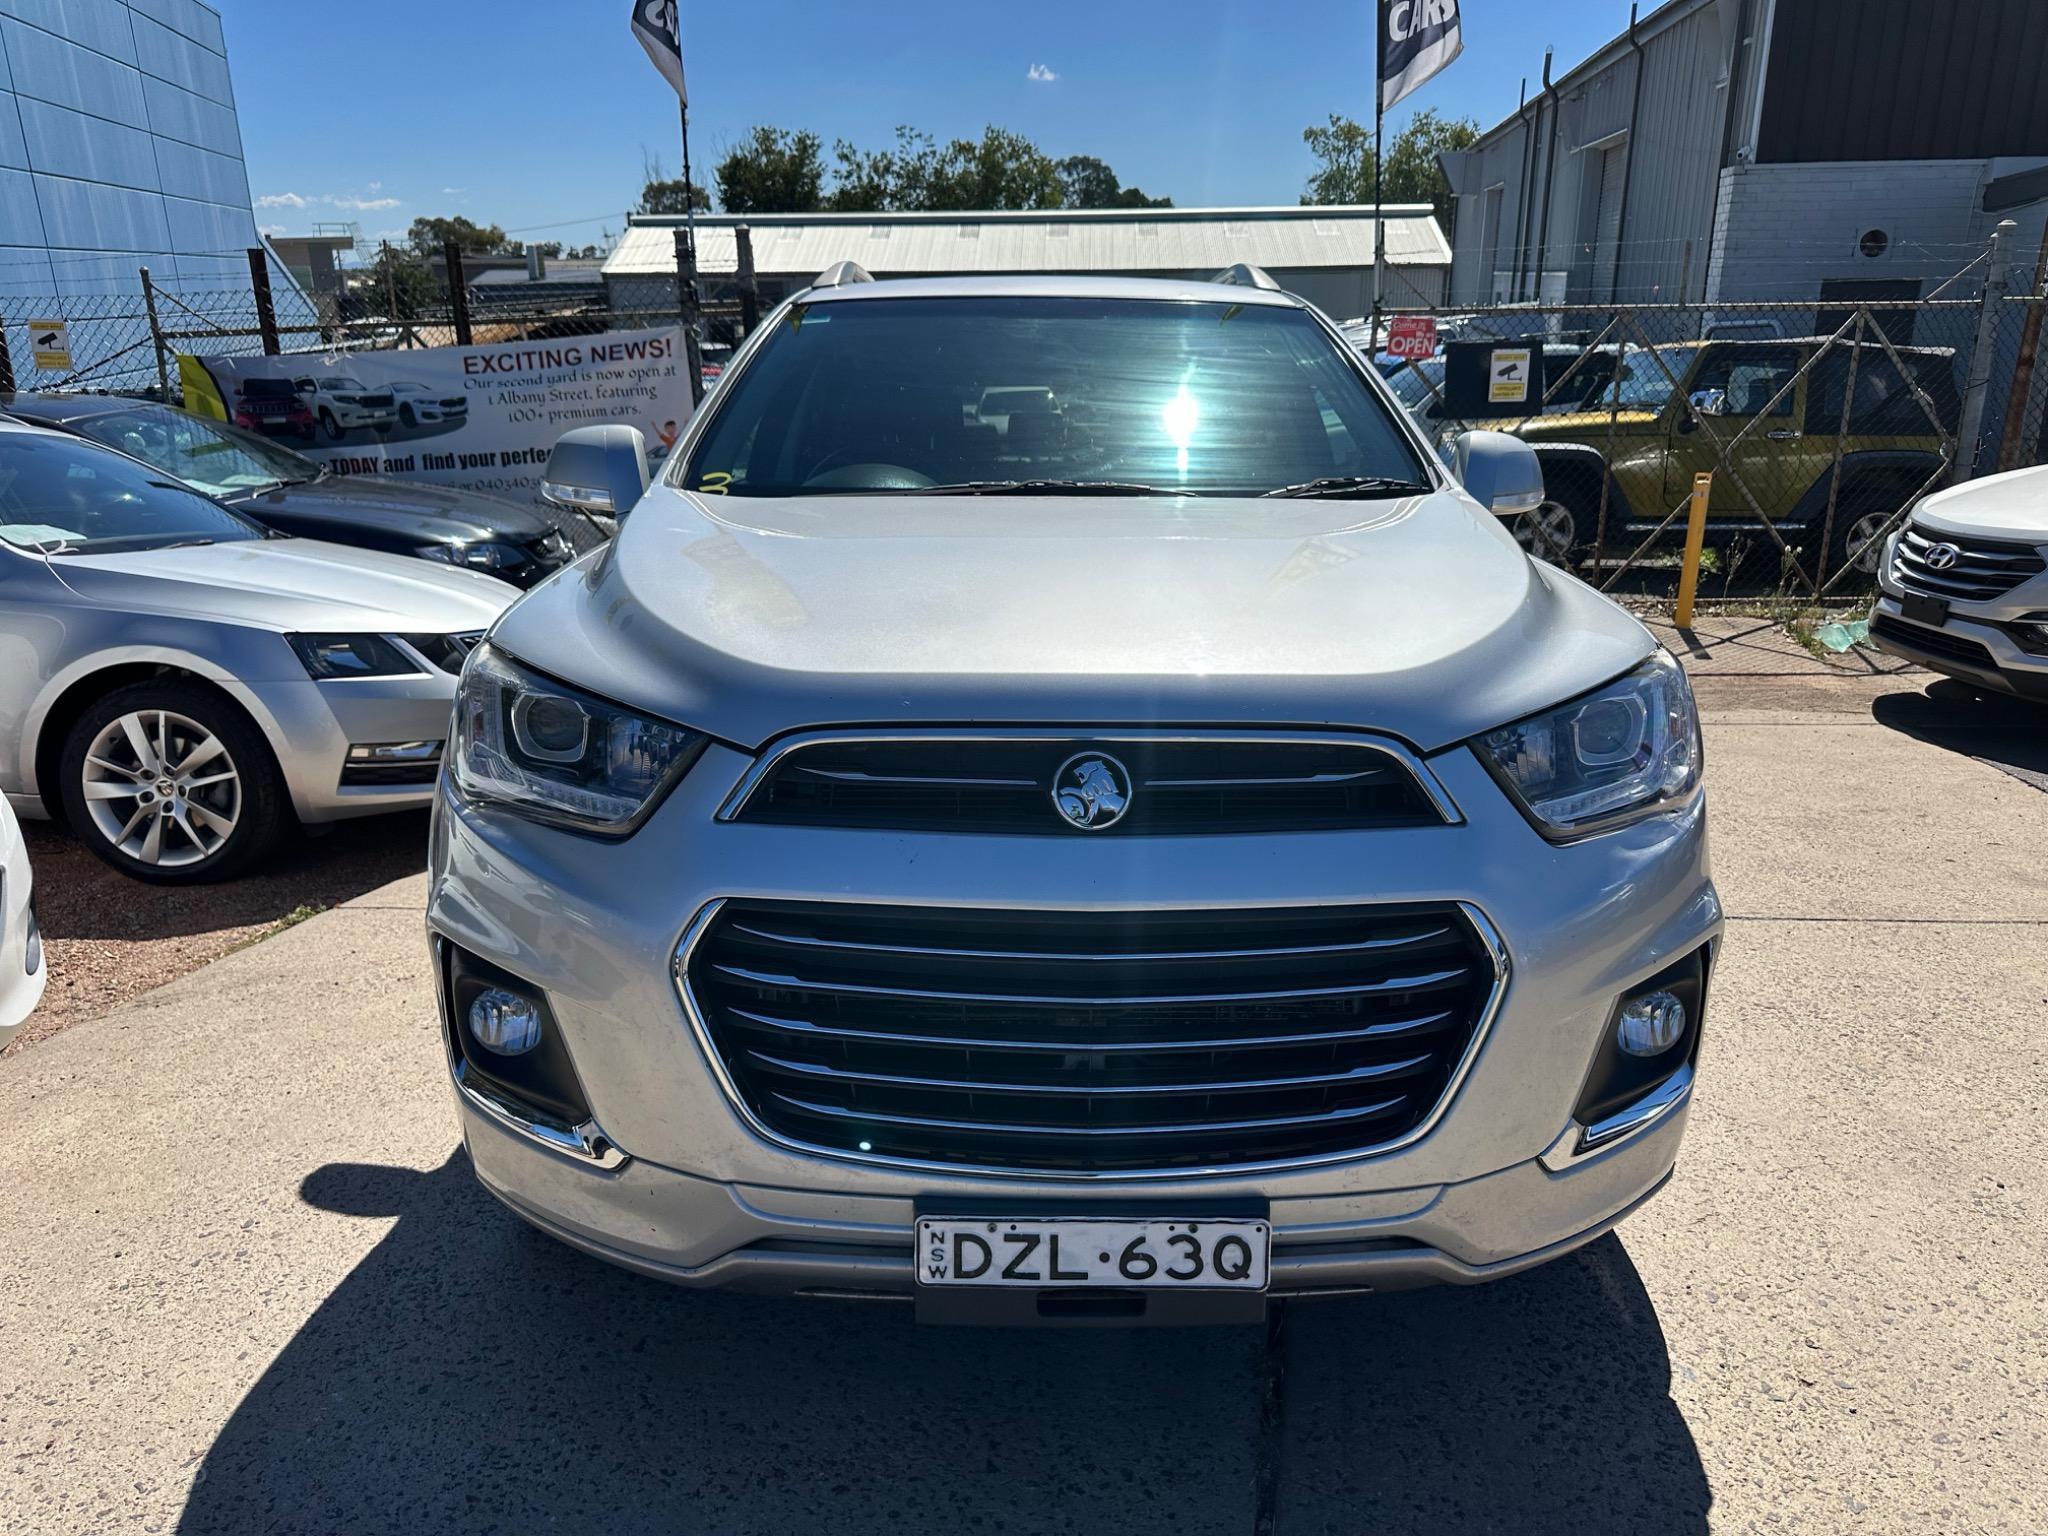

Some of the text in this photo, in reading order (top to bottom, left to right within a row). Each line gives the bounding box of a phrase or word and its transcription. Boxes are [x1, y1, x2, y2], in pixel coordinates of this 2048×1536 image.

[1389, 0, 1456, 41] CARS
[464, 338, 673, 375] EXCITING NEWS!
[1390, 336, 1434, 354] OPEN
[464, 364, 676, 390] Our second yard is now open at
[499, 390, 546, 406] Albany
[596, 383, 658, 400] featuring
[549, 405, 608, 424] premium
[611, 404, 642, 417] cars.
[329, 457, 379, 475] TODAY
[383, 455, 416, 472] and
[422, 452, 456, 471] find
[458, 452, 496, 470] your
[928, 1231, 947, 1279] NSW
